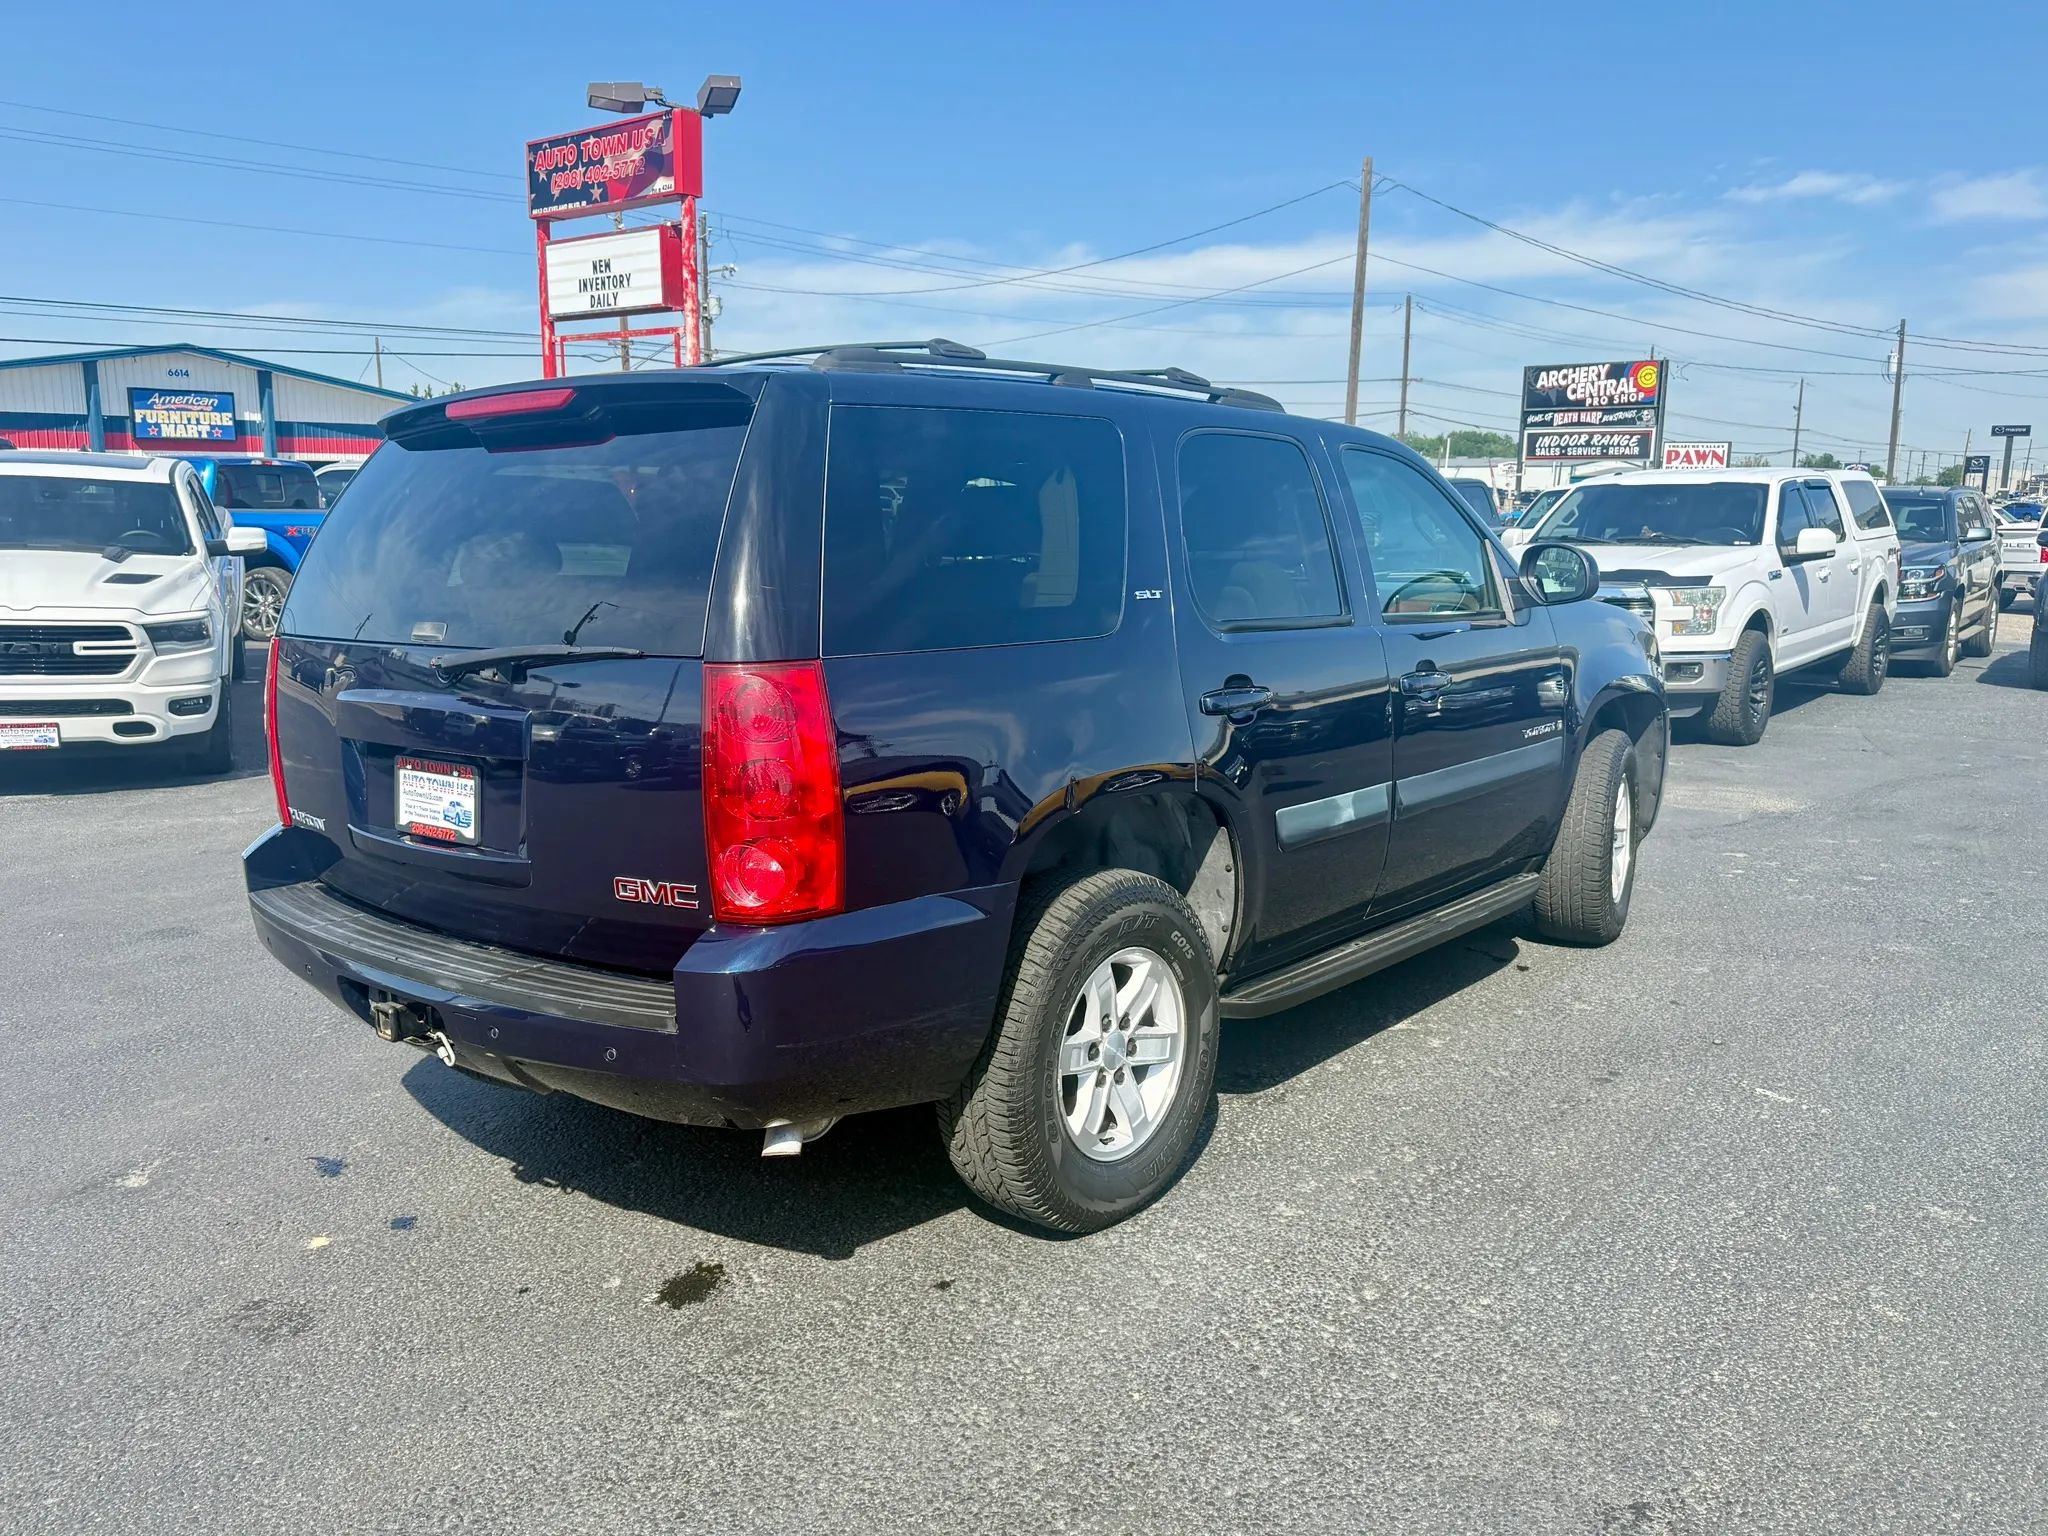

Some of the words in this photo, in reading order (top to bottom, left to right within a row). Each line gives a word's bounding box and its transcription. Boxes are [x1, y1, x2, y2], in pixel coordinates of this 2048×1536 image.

[535, 144, 577, 171] AUTO
[581, 132, 628, 162] TOWN
[632, 126, 666, 150] USA
[551, 170, 582, 193] (208)
[585, 156, 646, 184] 402-5772
[592, 258, 611, 275] NEW
[579, 273, 632, 293] INVENTORY
[590, 292, 618, 308] DAILY
[168, 368, 189, 378] 6614
[1536, 363, 1611, 389] ARCHERY
[1567, 377, 1637, 400] CENTRAL
[147, 392, 218, 407] American
[1586, 396, 1608, 407] PRO
[1614, 392, 1645, 404] SHOP
[134, 410, 233, 426] FURNITURE
[1527, 413, 1543, 424] HOME
[1544, 412, 1554, 421] OF
[1553, 412, 1578, 426] DEATH
[1580, 411, 1602, 424] HARP
[161, 424, 210, 438] MART
[1536, 435, 1588, 448] INDOOR
[1590, 434, 1640, 447] RANGE
[1535, 447, 1560, 456] SALES
[1567, 447, 1601, 456] SERVICE
[1608, 446, 1639, 455] REPAIR
[1665, 449, 1725, 465] PAWN
[1134, 589, 1163, 600] SLT
[397, 757, 421, 770] AUTO
[424, 760, 451, 774] TOWN
[403, 773, 425, 789] AUTO
[426, 778, 454, 795] TOWN
[614, 876, 699, 909] GMC
